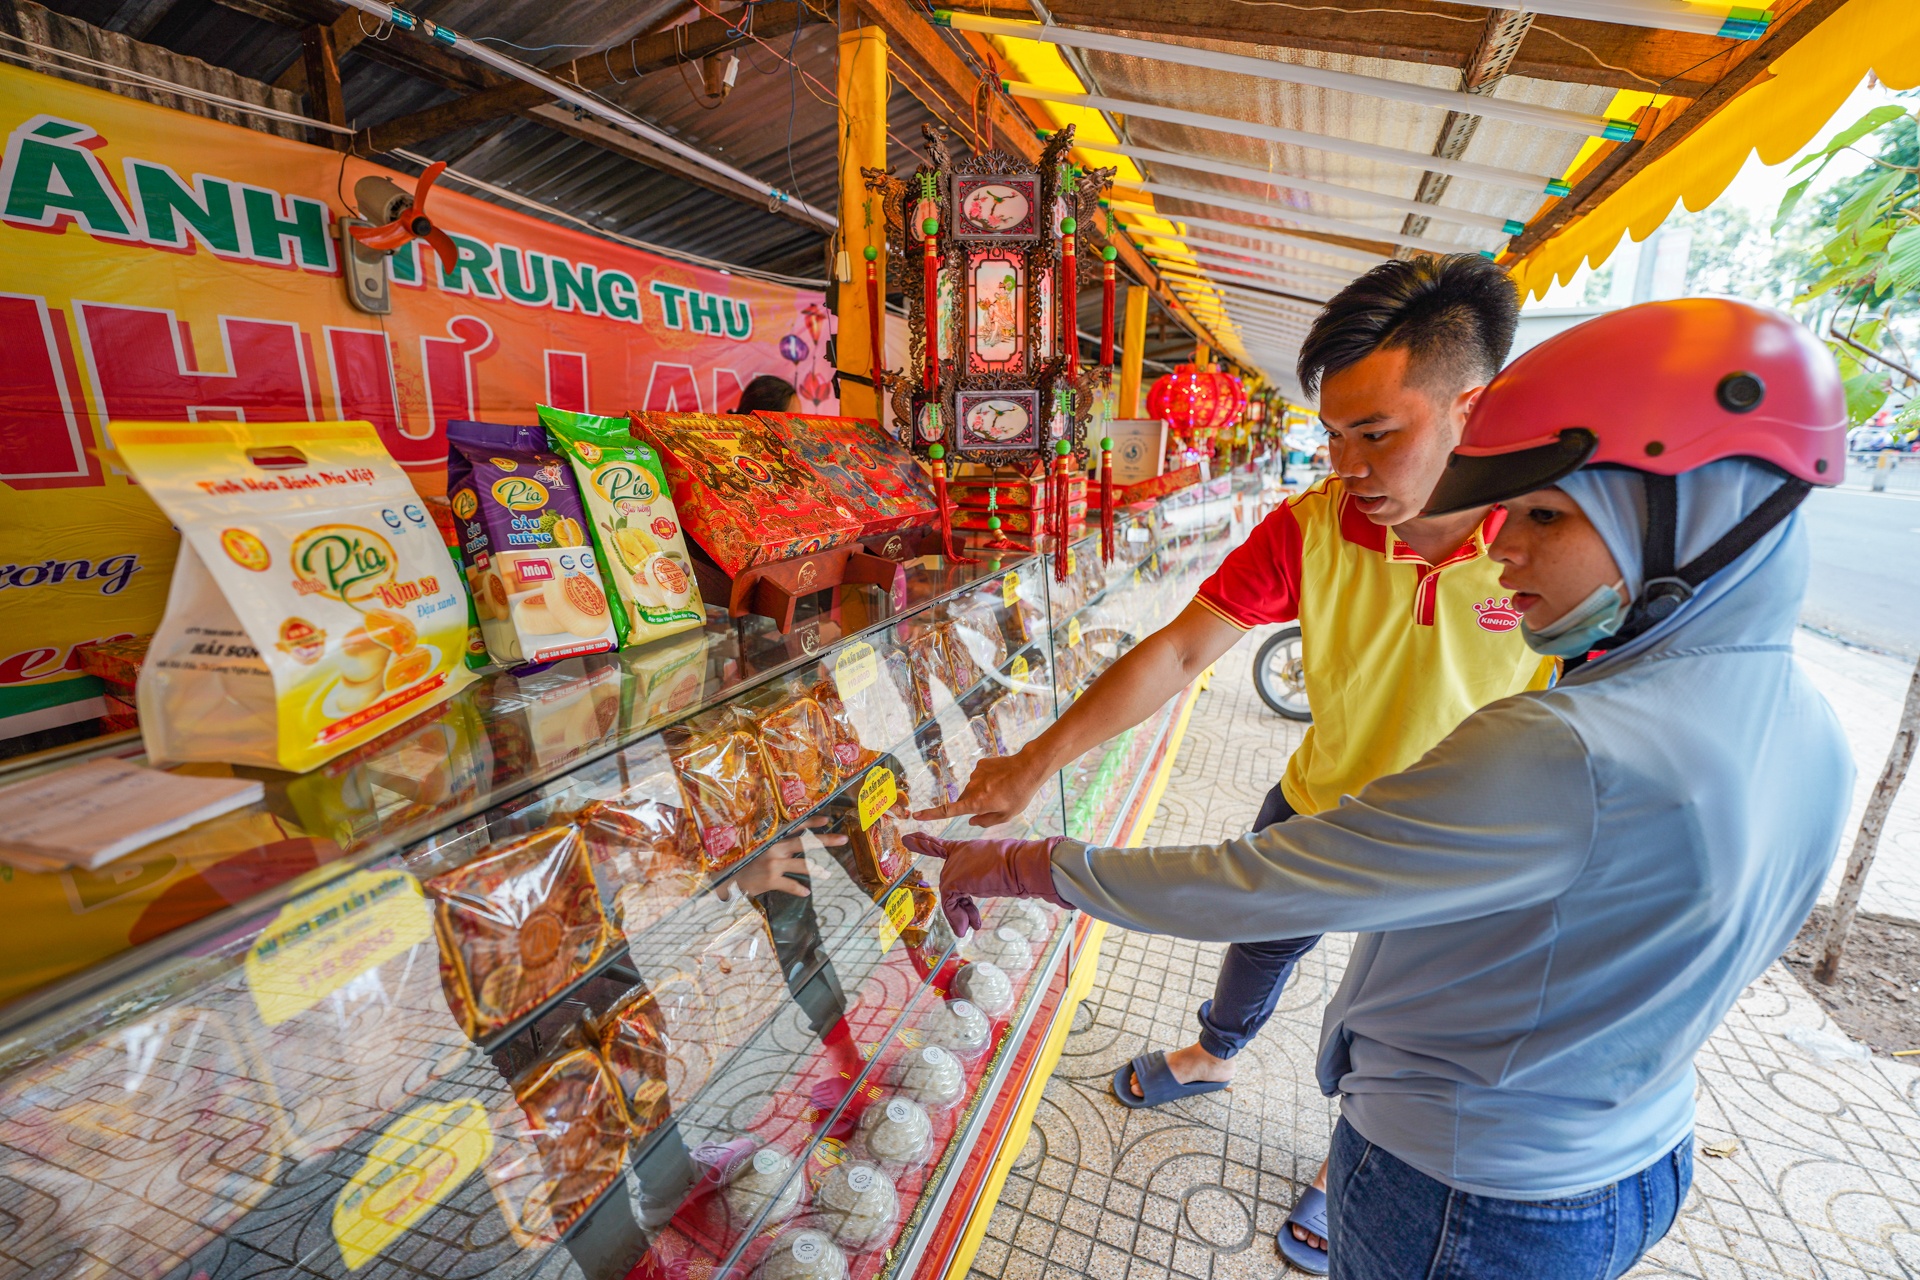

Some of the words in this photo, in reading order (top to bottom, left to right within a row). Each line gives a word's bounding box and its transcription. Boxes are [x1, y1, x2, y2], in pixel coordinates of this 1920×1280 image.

[388, 232, 638, 324] TRUNG
[651, 282, 752, 338] THU
[345, 468, 376, 486] Việt
[597, 466, 652, 500] Pía
[500, 480, 543, 511] Pía
[512, 514, 541, 530] SẦU
[509, 531, 552, 545] RIÊNG
[302, 534, 387, 591] Pía
[522, 565, 548, 577] Môn
[374, 582, 421, 608] Kim
[418, 576, 440, 596] sa
